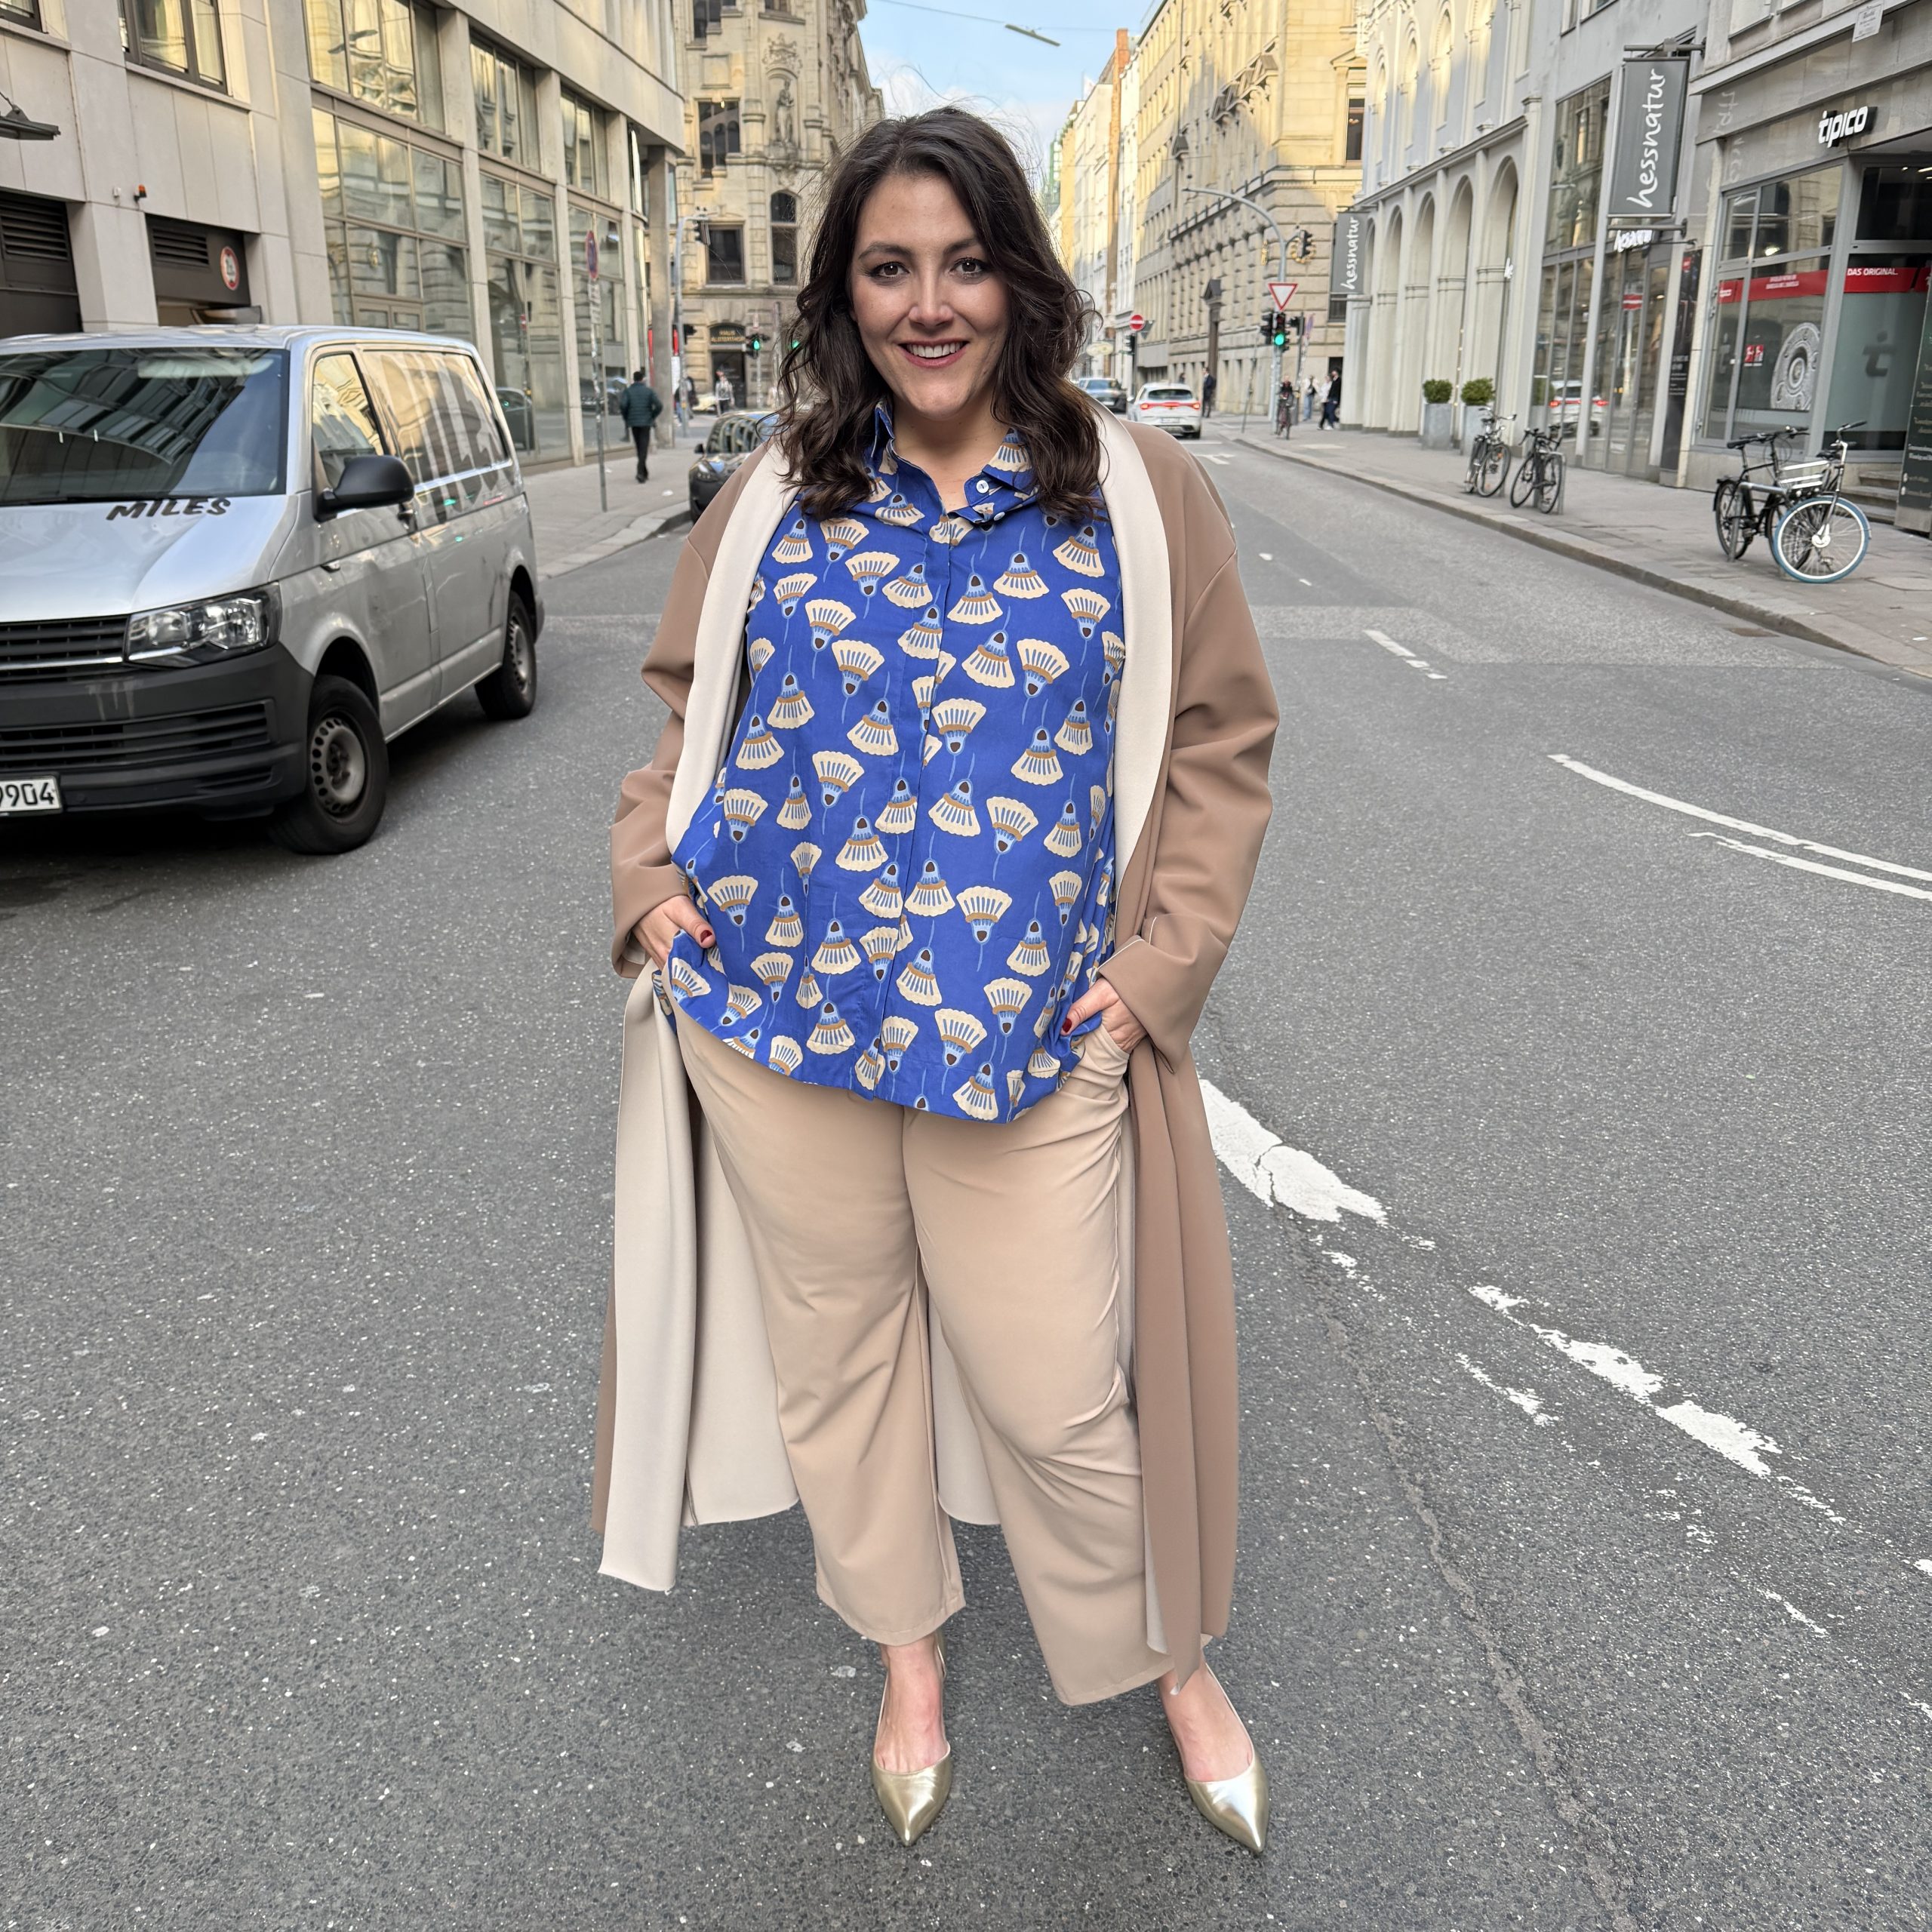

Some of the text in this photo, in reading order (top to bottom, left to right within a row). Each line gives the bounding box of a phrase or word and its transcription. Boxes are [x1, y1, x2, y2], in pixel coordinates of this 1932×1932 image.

[1626, 68, 1666, 208] hessnatur
[1818, 106, 1869, 149] tipico
[1340, 217, 1360, 290] hessnatur
[1847, 268, 1862, 276] DAS
[106, 497, 231, 521] MILES
[0, 782, 54, 808] 904
